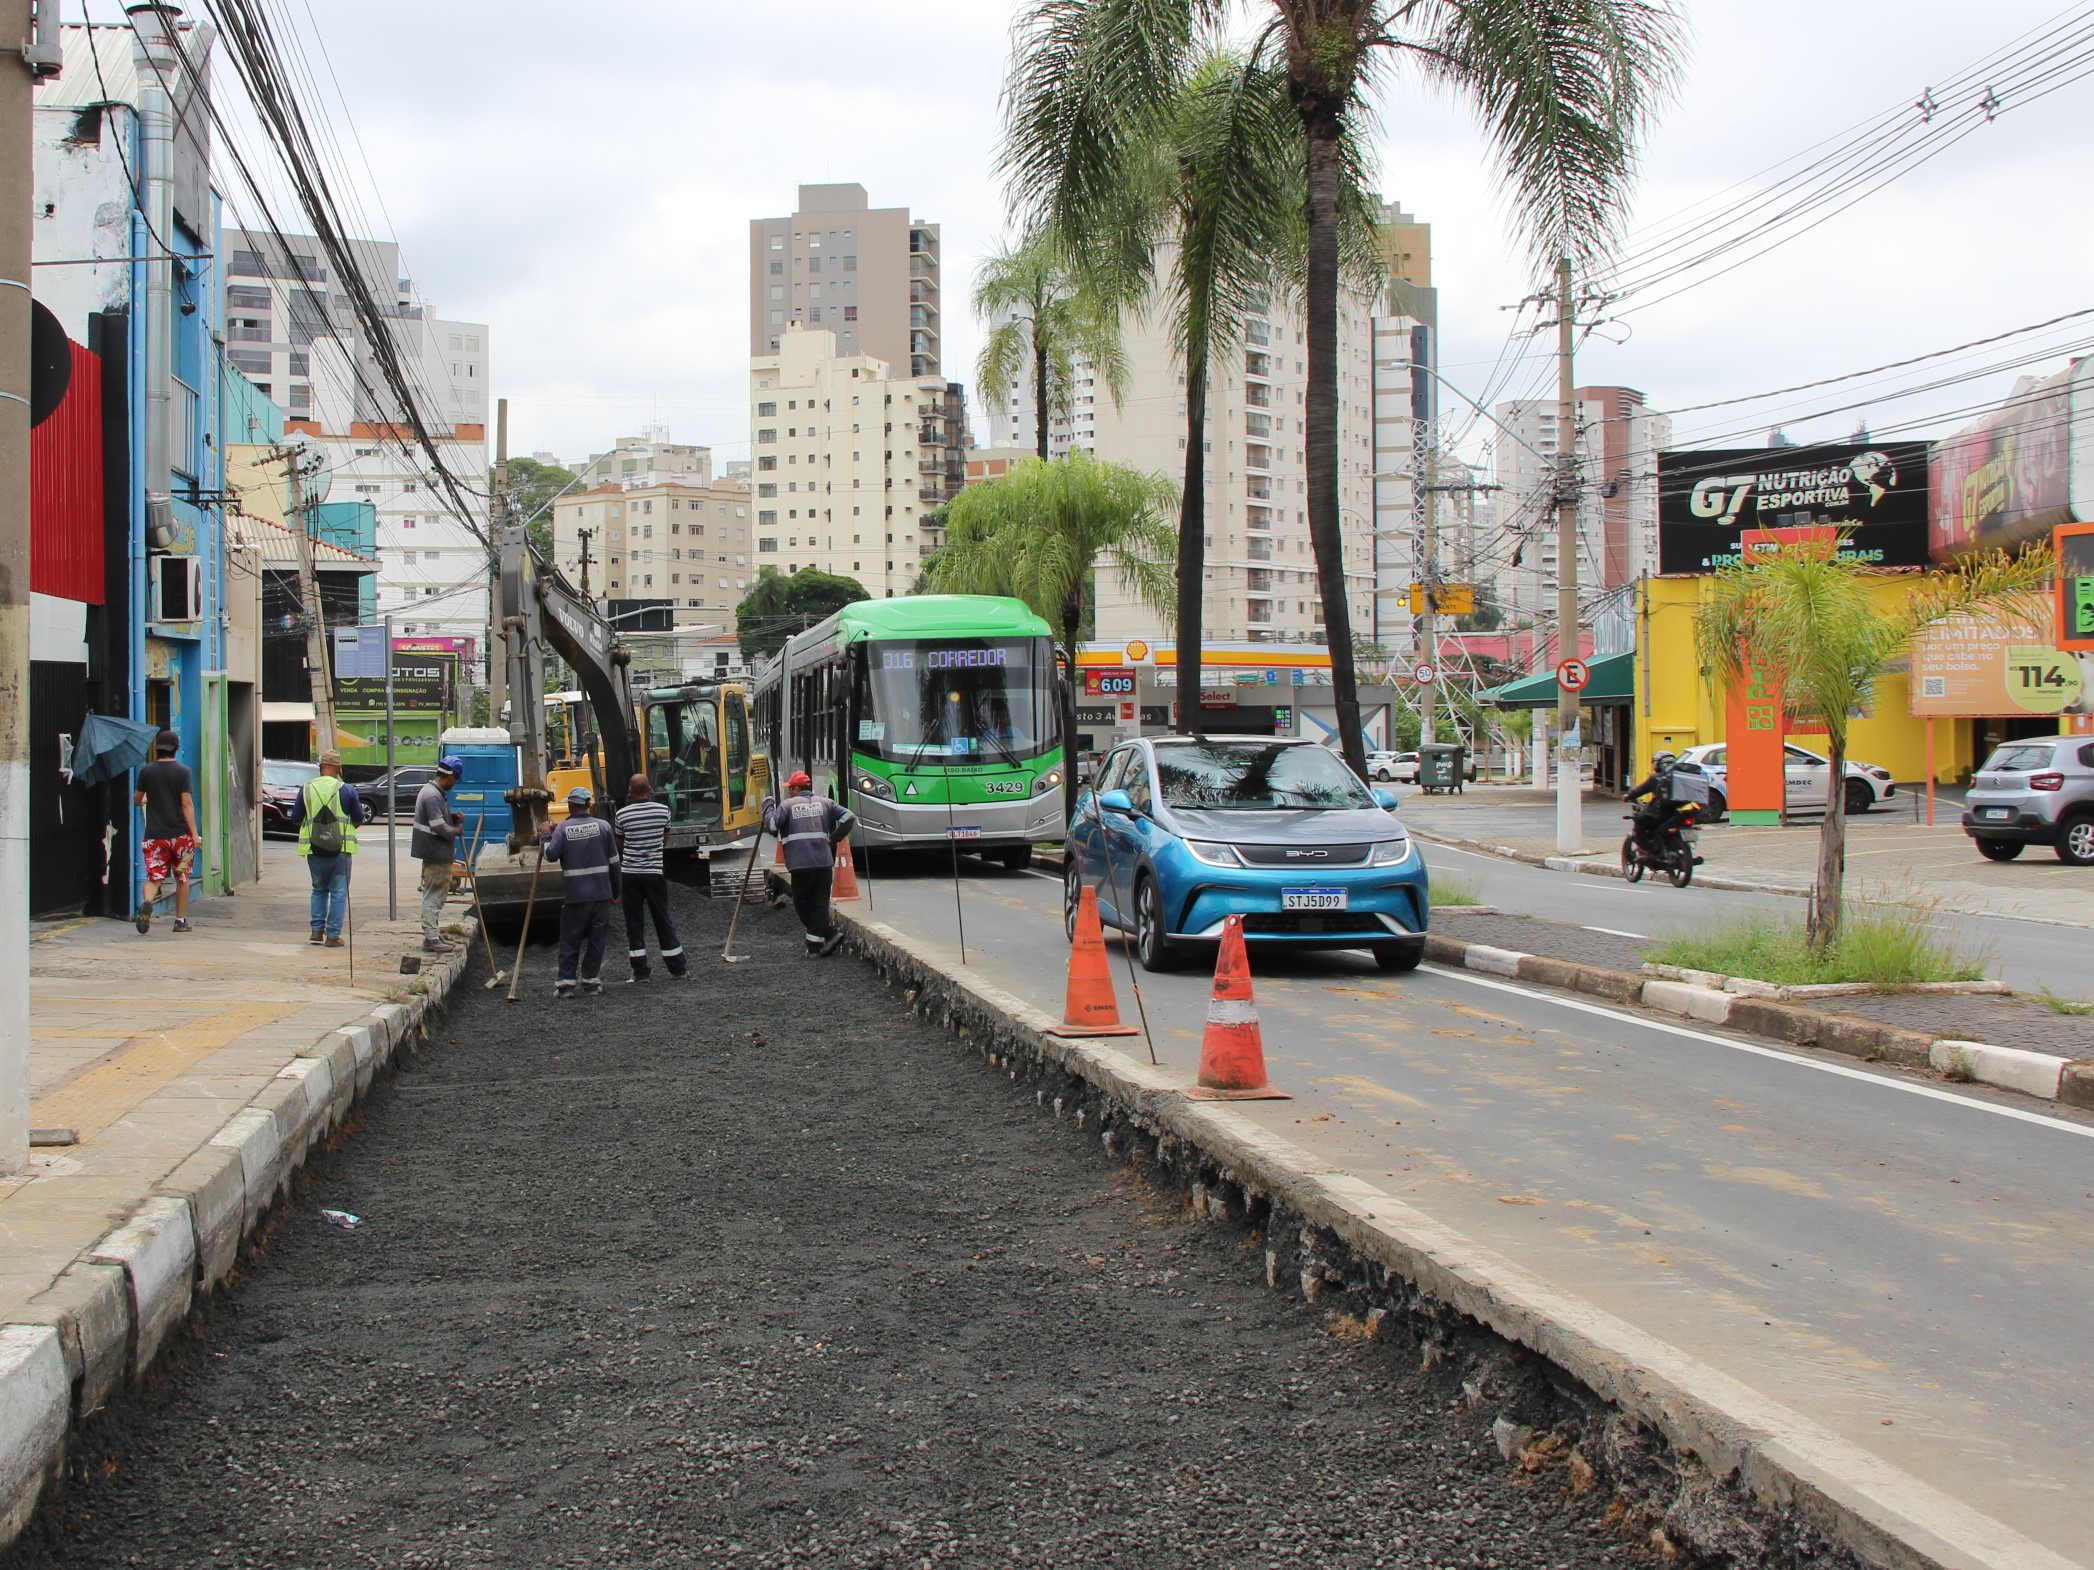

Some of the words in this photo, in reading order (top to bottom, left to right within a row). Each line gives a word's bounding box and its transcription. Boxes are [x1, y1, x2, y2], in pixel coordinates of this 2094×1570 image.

[1690, 474, 1756, 519] G7
[1758, 466, 1850, 491] NUTRIÇÃO
[1756, 487, 1849, 510] ESPORTIVA
[558, 608, 584, 639] VOLVO
[1923, 643, 1941, 651] por
[1968, 643, 2000, 651] preço
[883, 653, 913, 669] 316
[928, 649, 1006, 668] CORREDOR
[1923, 654, 1945, 662] que
[1419, 668, 1431, 678] 50
[1567, 665, 1578, 683] E
[1200, 691, 1230, 700] Select
[1076, 712, 1093, 720] sto
[1095, 712, 1102, 720] 3
[986, 782, 1024, 794] 3429
[1288, 896, 1340, 907] STJ5D99
